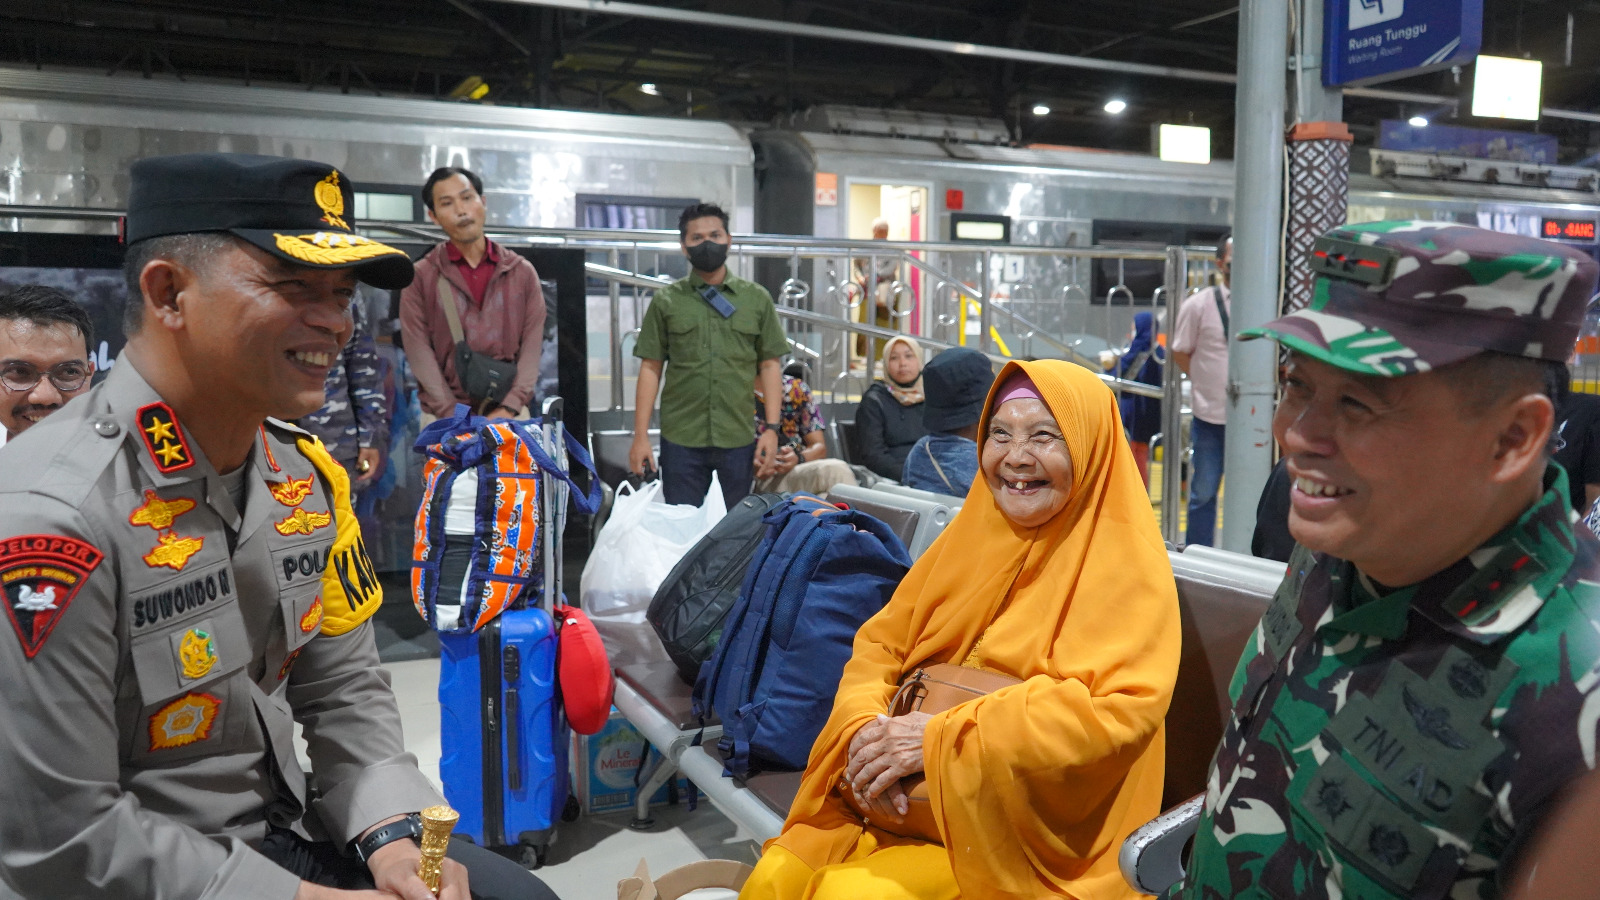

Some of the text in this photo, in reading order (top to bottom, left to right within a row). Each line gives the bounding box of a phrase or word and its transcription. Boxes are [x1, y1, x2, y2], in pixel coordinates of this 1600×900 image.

[1348, 24, 1427, 51] Ruang Tunggu
[1012, 261, 1018, 275] 1
[133, 567, 231, 628] SUWONDO N
[617, 749, 630, 759] Le
[1353, 715, 1454, 813] TNI AD
